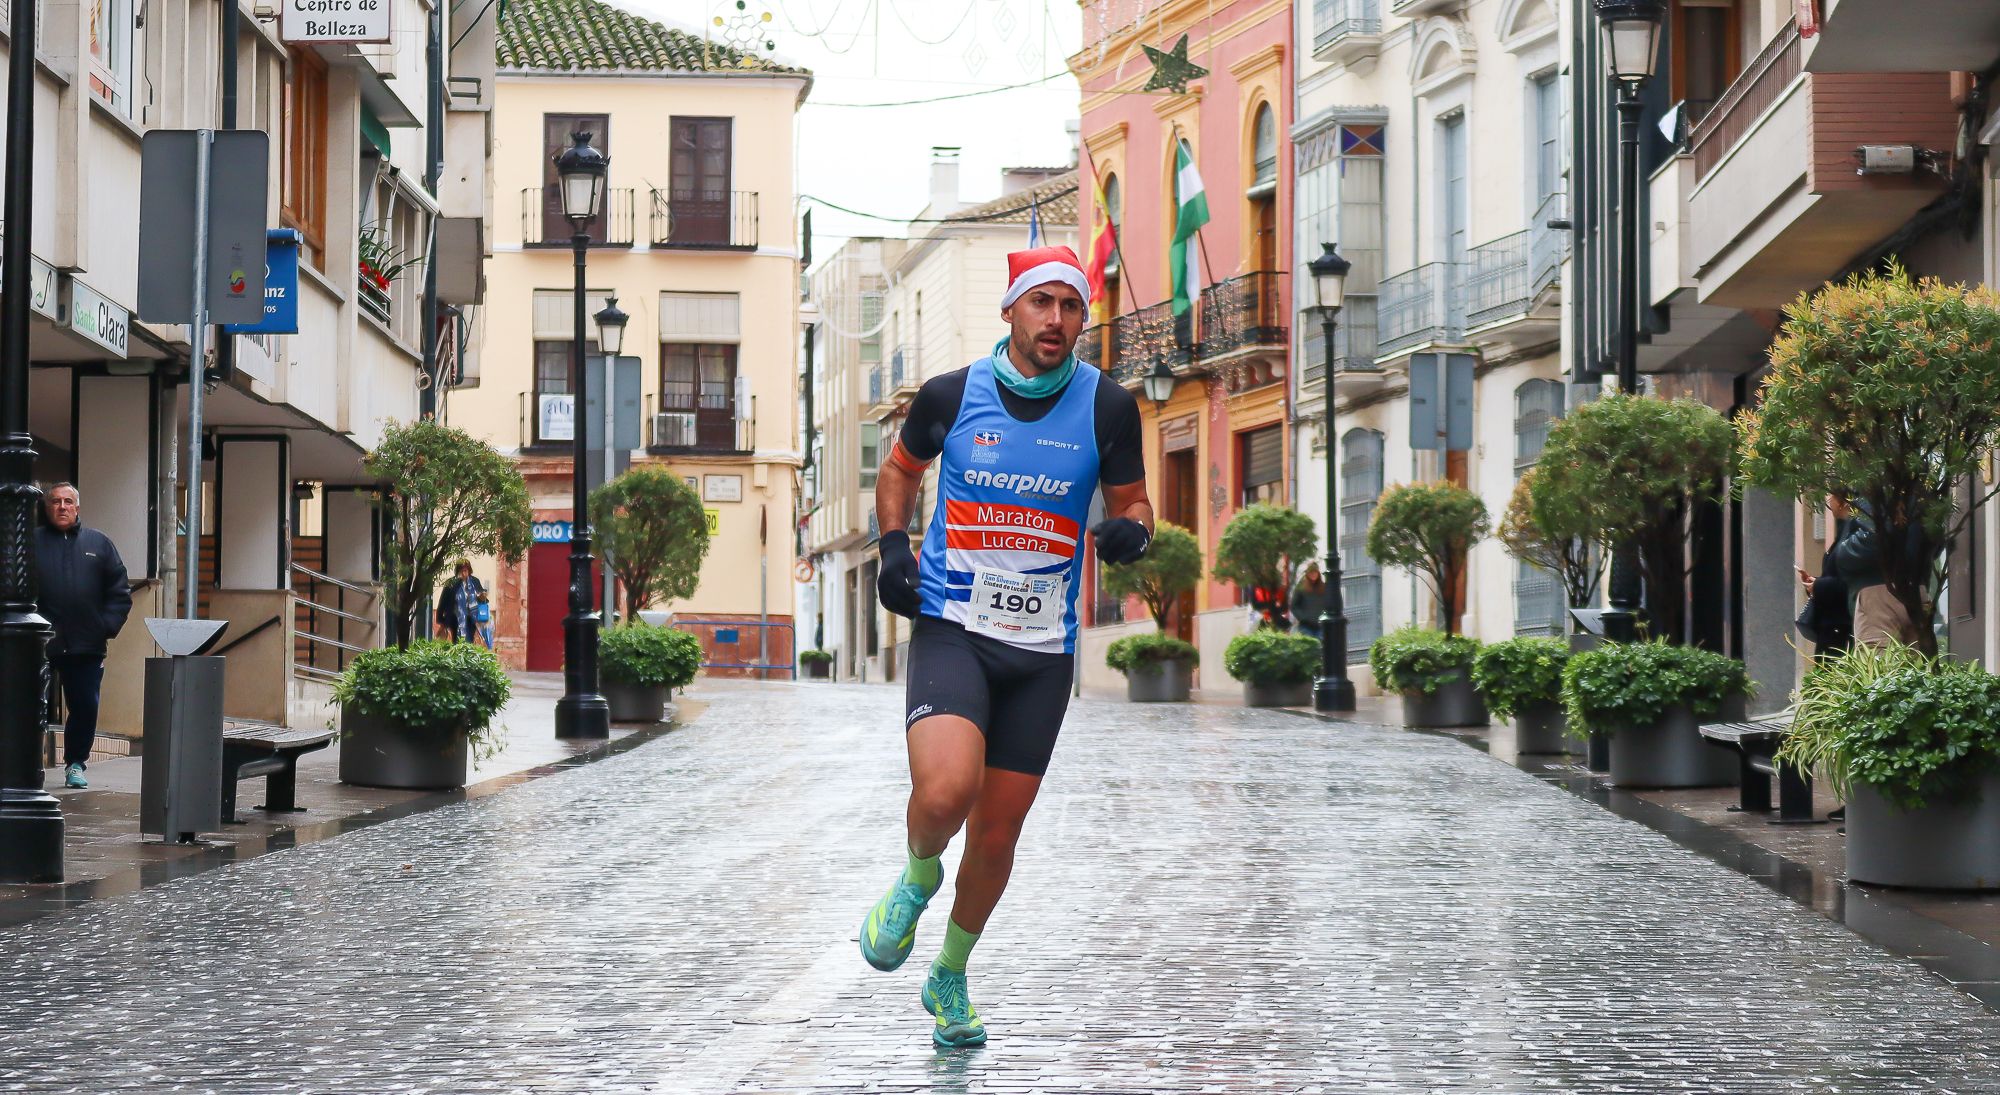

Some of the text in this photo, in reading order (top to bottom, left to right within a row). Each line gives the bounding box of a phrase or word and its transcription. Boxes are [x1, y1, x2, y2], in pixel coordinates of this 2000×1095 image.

[294, 0, 378, 14] Centro de
[305, 20, 367, 36] Belleza
[74, 301, 126, 351] Santa Clara
[963, 468, 1074, 497] enerplus
[977, 505, 1056, 532] Maratón
[532, 523, 563, 540] ORO
[981, 531, 1049, 553] Lucena
[983, 580, 1002, 589] Ciudad
[1010, 585, 1029, 593] Lucena
[989, 591, 1042, 615] 190
